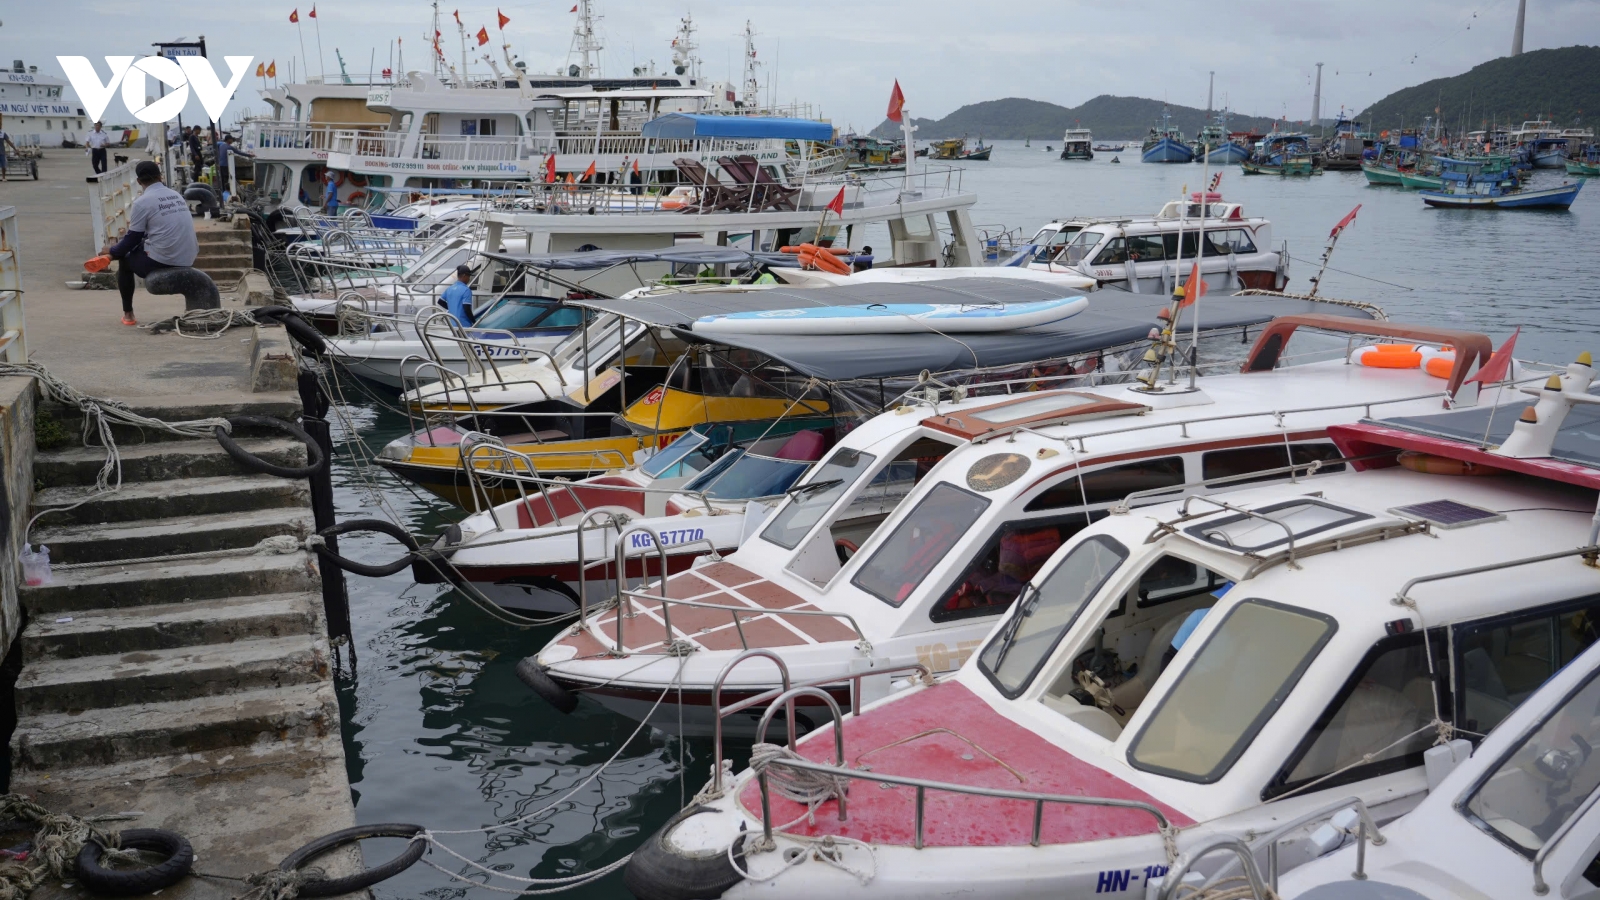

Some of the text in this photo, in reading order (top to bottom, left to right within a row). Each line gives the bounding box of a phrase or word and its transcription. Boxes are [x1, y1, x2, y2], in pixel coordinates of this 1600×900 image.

[167, 47, 181, 56] BẾN
[8, 74, 34, 82] KN-508
[52, 105, 70, 114] NAM
[631, 528, 704, 548] KG-57770
